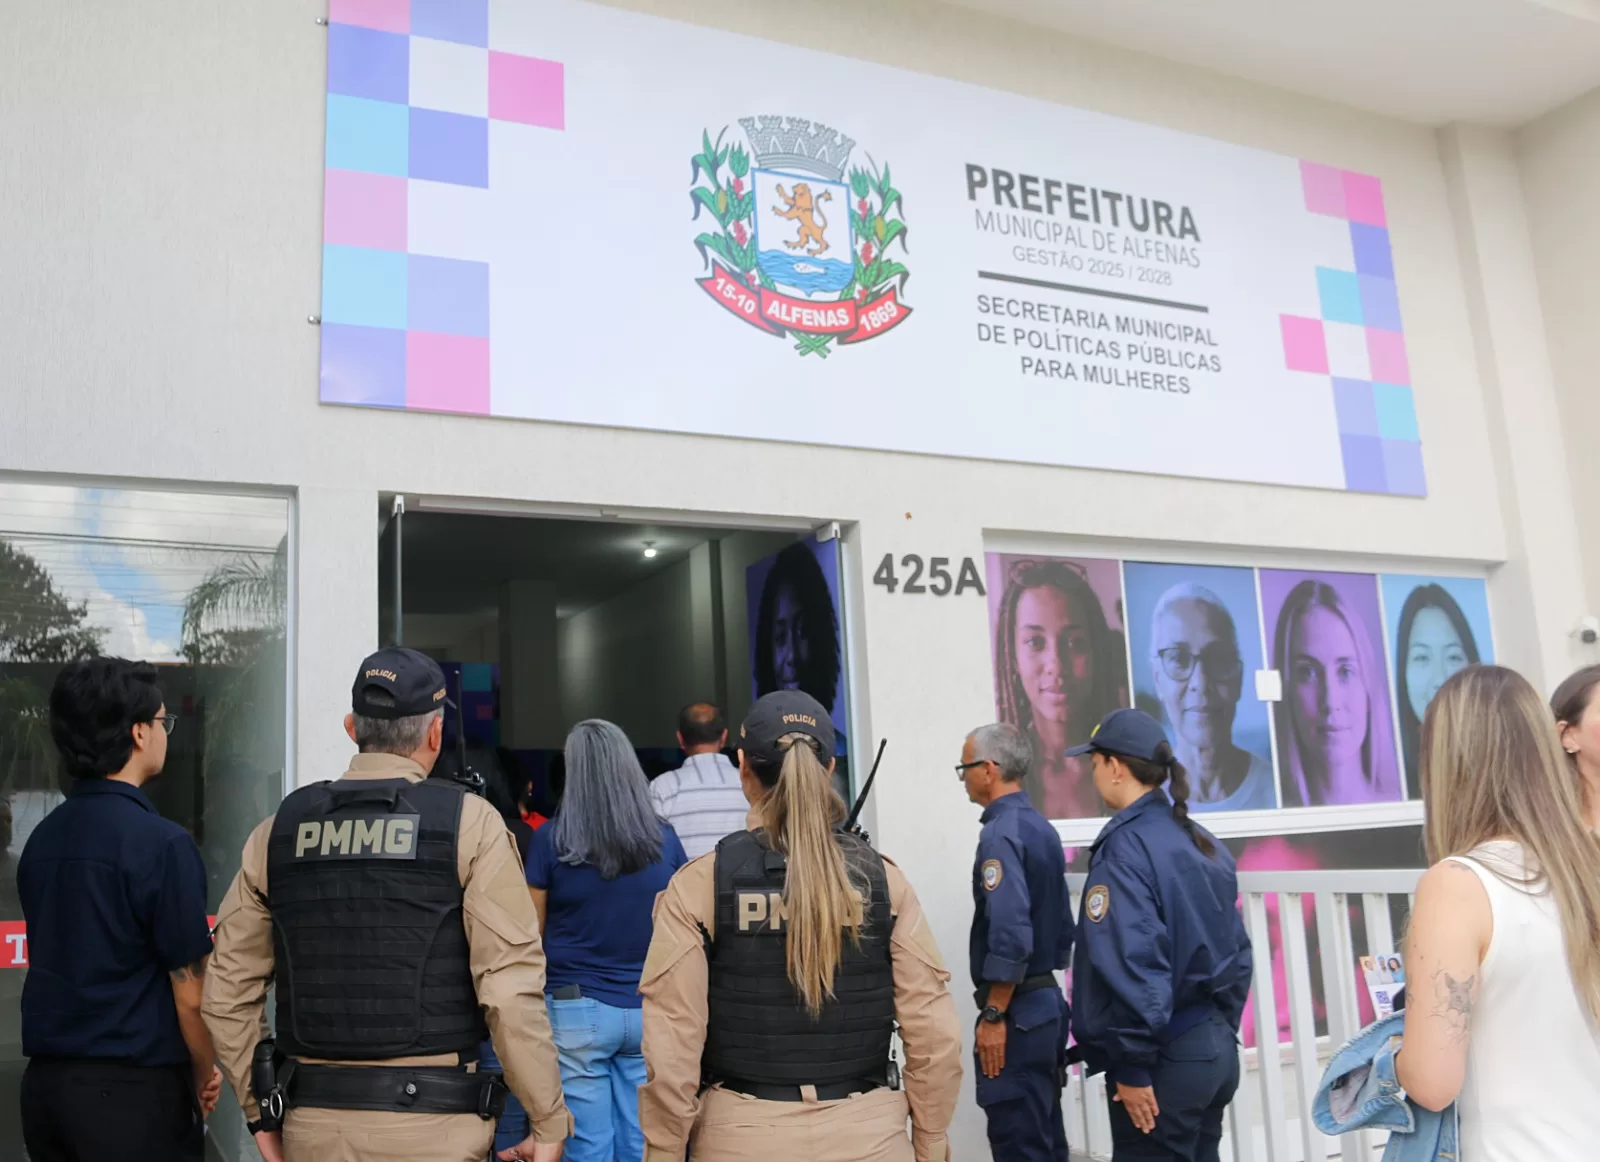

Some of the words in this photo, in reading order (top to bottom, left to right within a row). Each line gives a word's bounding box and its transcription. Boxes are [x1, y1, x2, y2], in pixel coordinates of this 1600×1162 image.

[965, 163, 1201, 243] PREFEITURA
[974, 208, 1088, 249] MUNICIPAL
[1092, 229, 1118, 254] DE
[1122, 236, 1201, 269] ALFENAS
[1012, 244, 1084, 271] GESTÃO
[1087, 257, 1125, 279] 2025
[1137, 266, 1172, 286] 2028
[715, 277, 756, 314] 15-10
[767, 300, 850, 327] ALFENAS
[859, 301, 898, 332] 1869
[976, 294, 1112, 332] SECRETARIA
[1114, 315, 1219, 347] MUNICIPAL
[976, 323, 1007, 344] DE
[1013, 328, 1121, 360] POLÍTICAS
[1127, 341, 1222, 373] PÚBLICAS
[1020, 356, 1078, 381] PARA
[1083, 364, 1191, 394] MULHERES
[873, 553, 986, 596] 425A
[295, 819, 414, 858] PMMG
